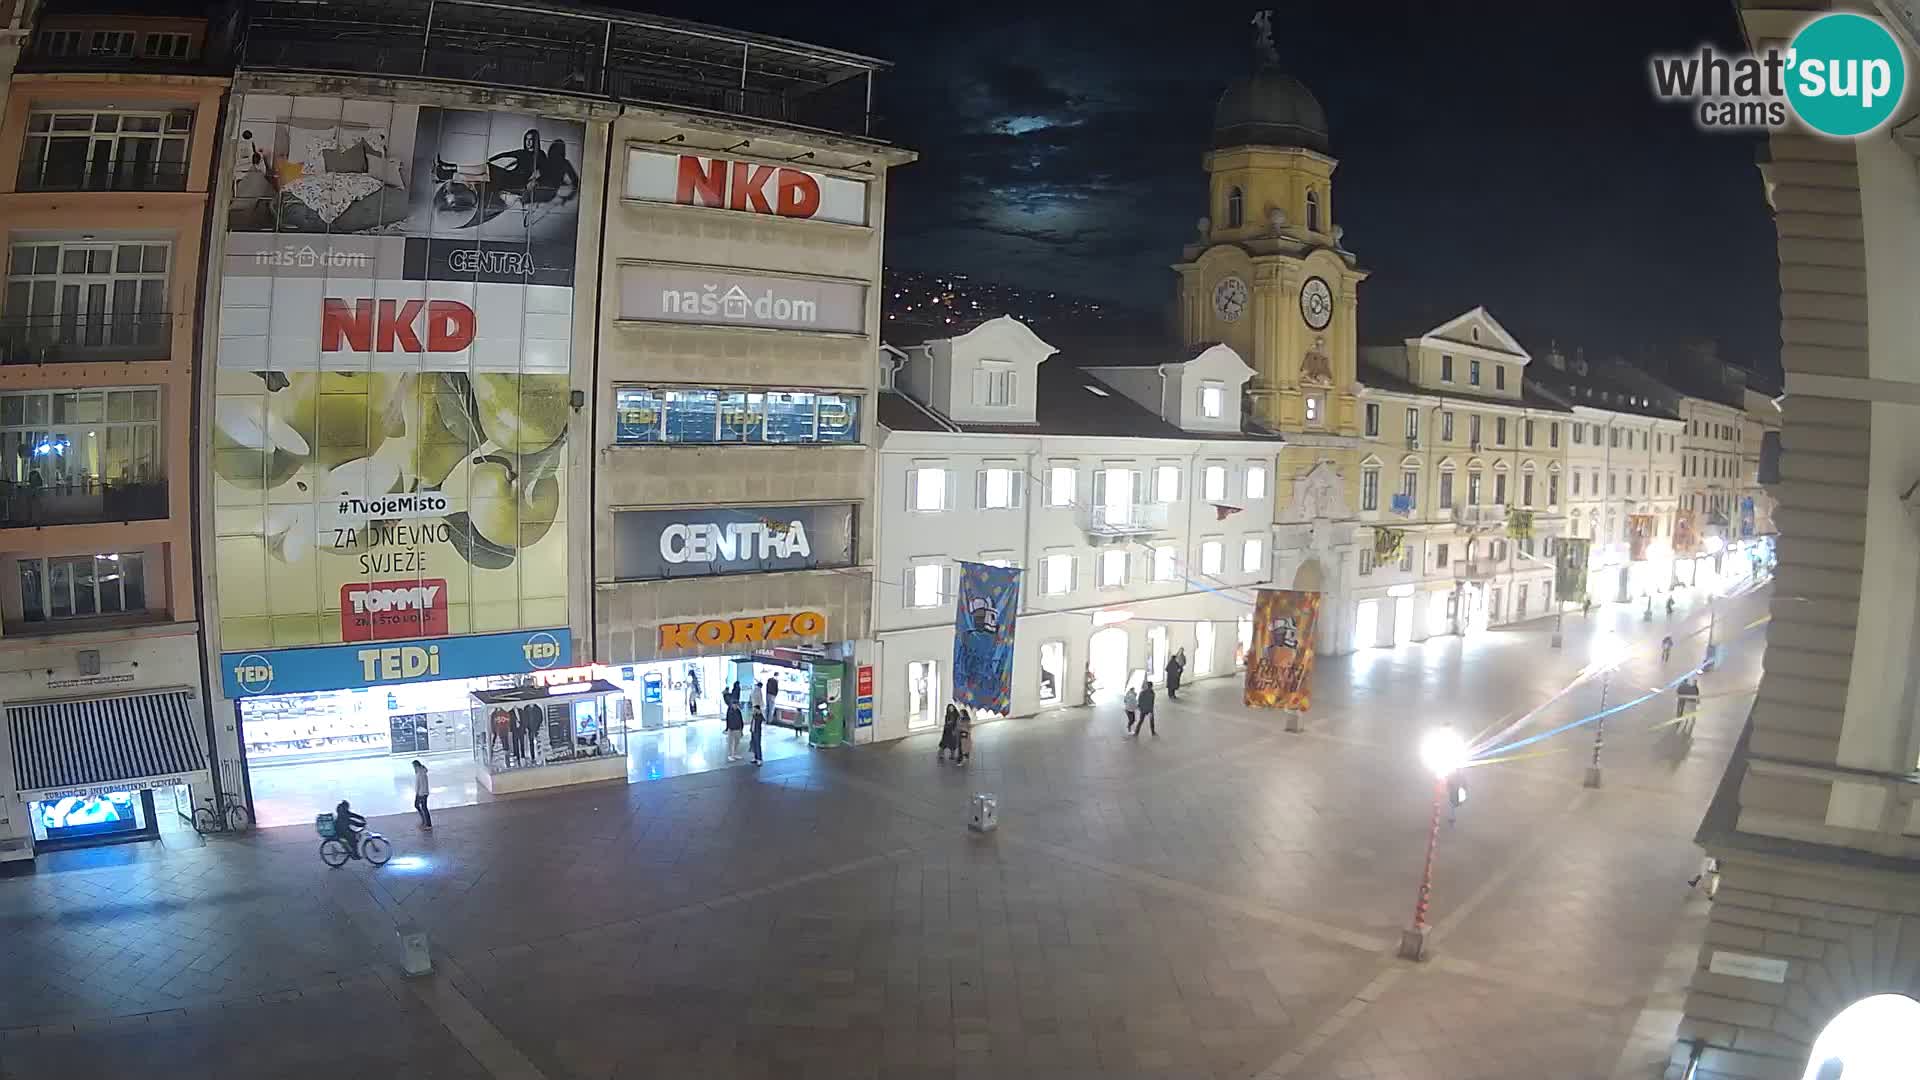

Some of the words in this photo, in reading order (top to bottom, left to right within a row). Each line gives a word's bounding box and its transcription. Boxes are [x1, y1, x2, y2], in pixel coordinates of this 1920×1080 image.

[676, 155, 820, 219] NKD
[256, 245, 294, 265] naš
[320, 247, 367, 267] dom
[449, 249, 535, 275] CENTRA
[662, 284, 718, 316] naš
[754, 289, 817, 322] dom
[321, 297, 477, 353] NKD
[339, 496, 447, 516] #TvojeMisto
[334, 527, 358, 548] ZA
[367, 524, 450, 548] DNEVNO
[660, 520, 811, 564] CENTRA
[360, 547, 427, 574] SVJEŽE
[348, 586, 440, 613] TOMMY
[660, 611, 826, 651] KORZO
[358, 645, 439, 681] TEDi
[523, 642, 560, 659] TEDi
[234, 665, 273, 682] TEDi
